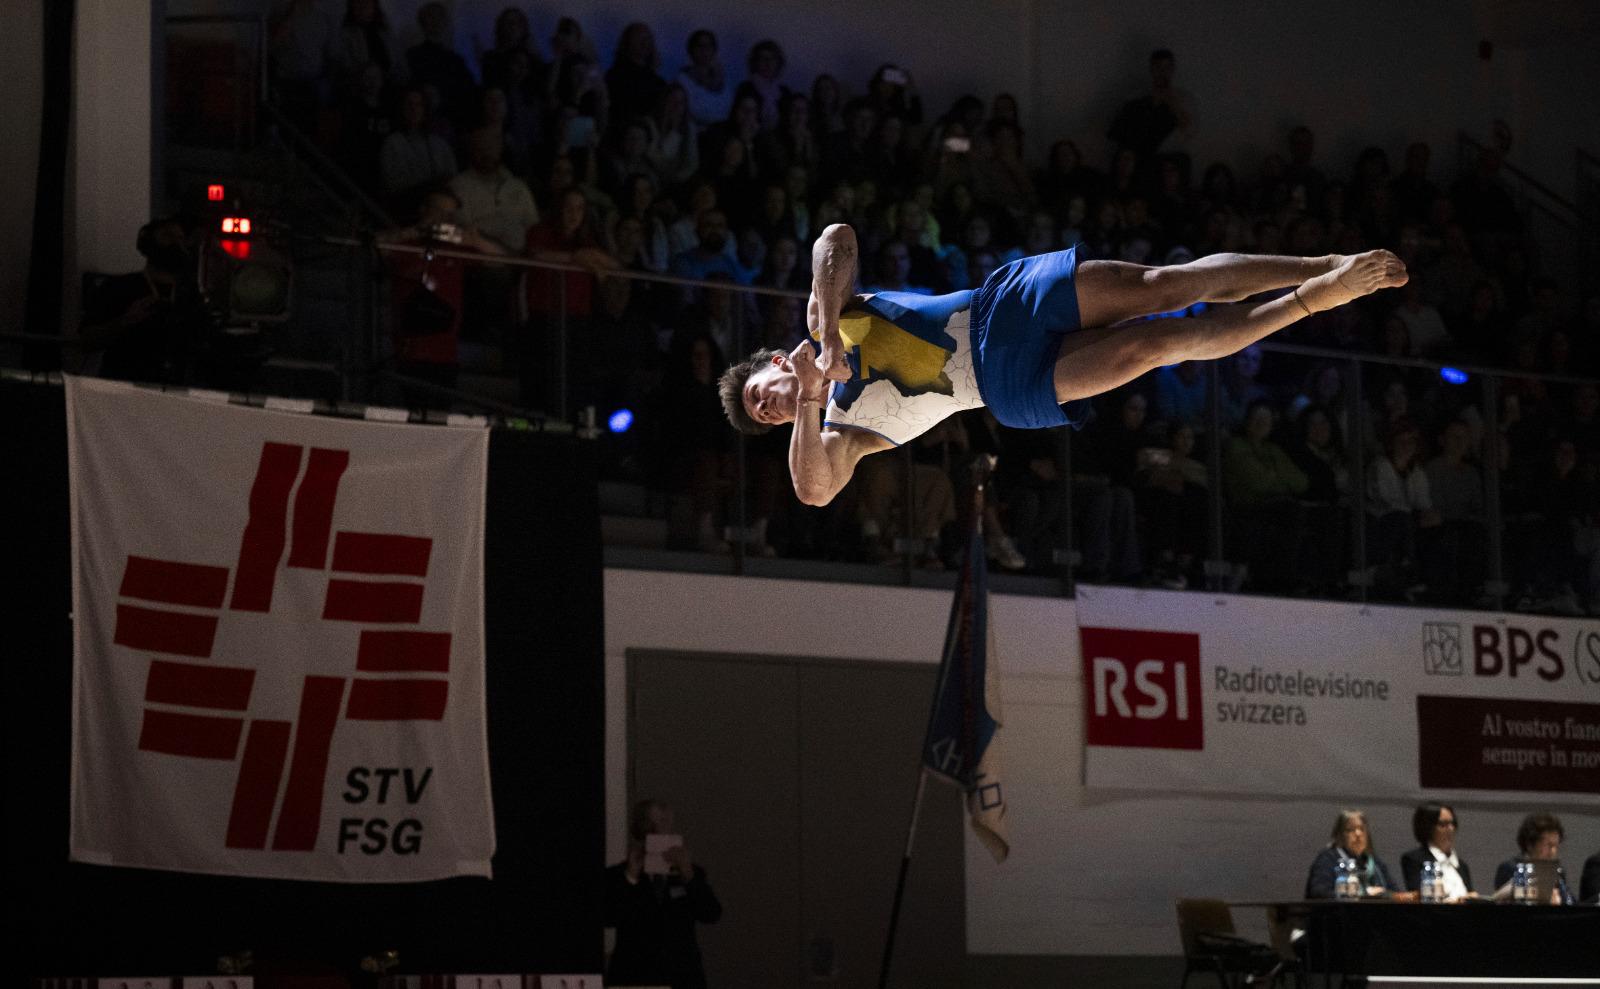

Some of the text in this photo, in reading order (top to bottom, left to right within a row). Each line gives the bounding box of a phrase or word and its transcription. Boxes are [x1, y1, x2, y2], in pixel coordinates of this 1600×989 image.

[1474, 626, 1564, 681] BPS
[1093, 657, 1189, 721] RSI
[1215, 665, 1389, 701] Radiotelevisione
[1217, 699, 1307, 727] svizzera
[1481, 712, 1503, 737] Al
[1504, 718, 1561, 740] vostro
[1481, 747, 1549, 771] sempre
[1550, 744, 1568, 768] in
[343, 765, 433, 804] STV
[338, 818, 423, 855] FSG
